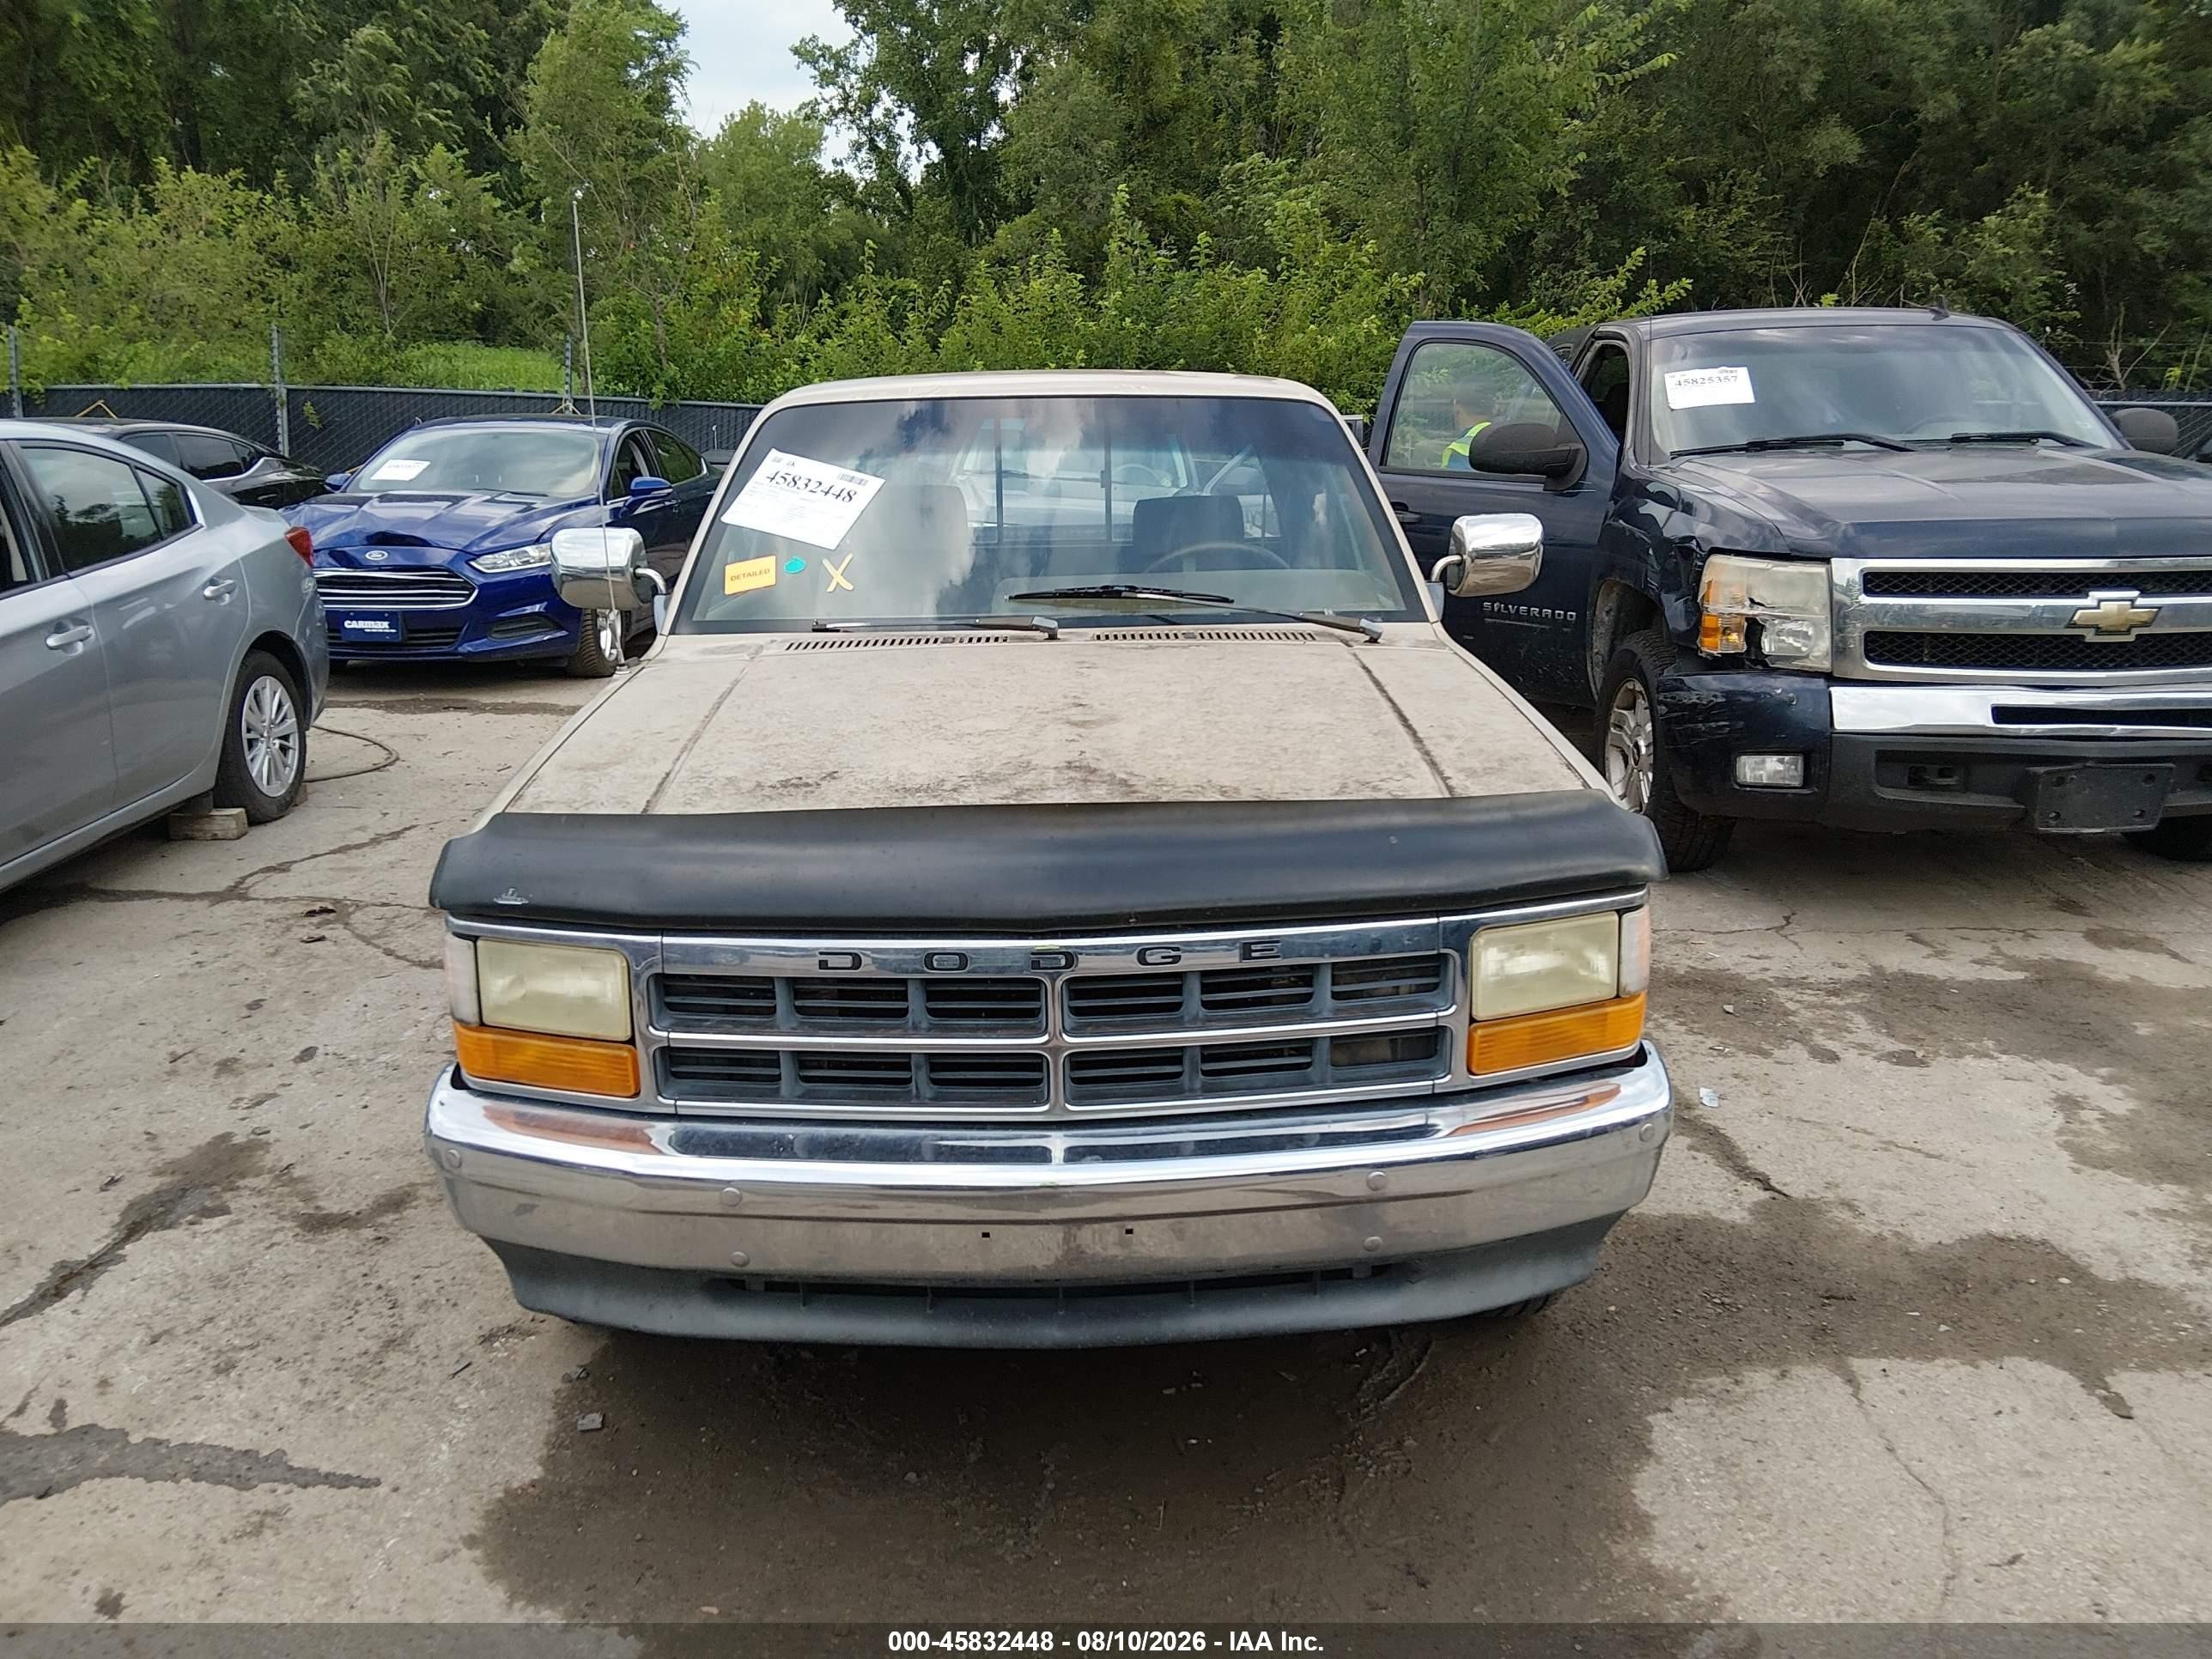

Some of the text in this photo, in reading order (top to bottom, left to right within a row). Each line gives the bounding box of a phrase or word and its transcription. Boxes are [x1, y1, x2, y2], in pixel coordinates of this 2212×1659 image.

[1674, 375, 1738, 386] 45825357
[766, 470, 857, 503] 45832448
[730, 568, 770, 581] DETAILED
[1482, 601, 1577, 621] SILVERADO
[817, 940, 1282, 971] DODGE
